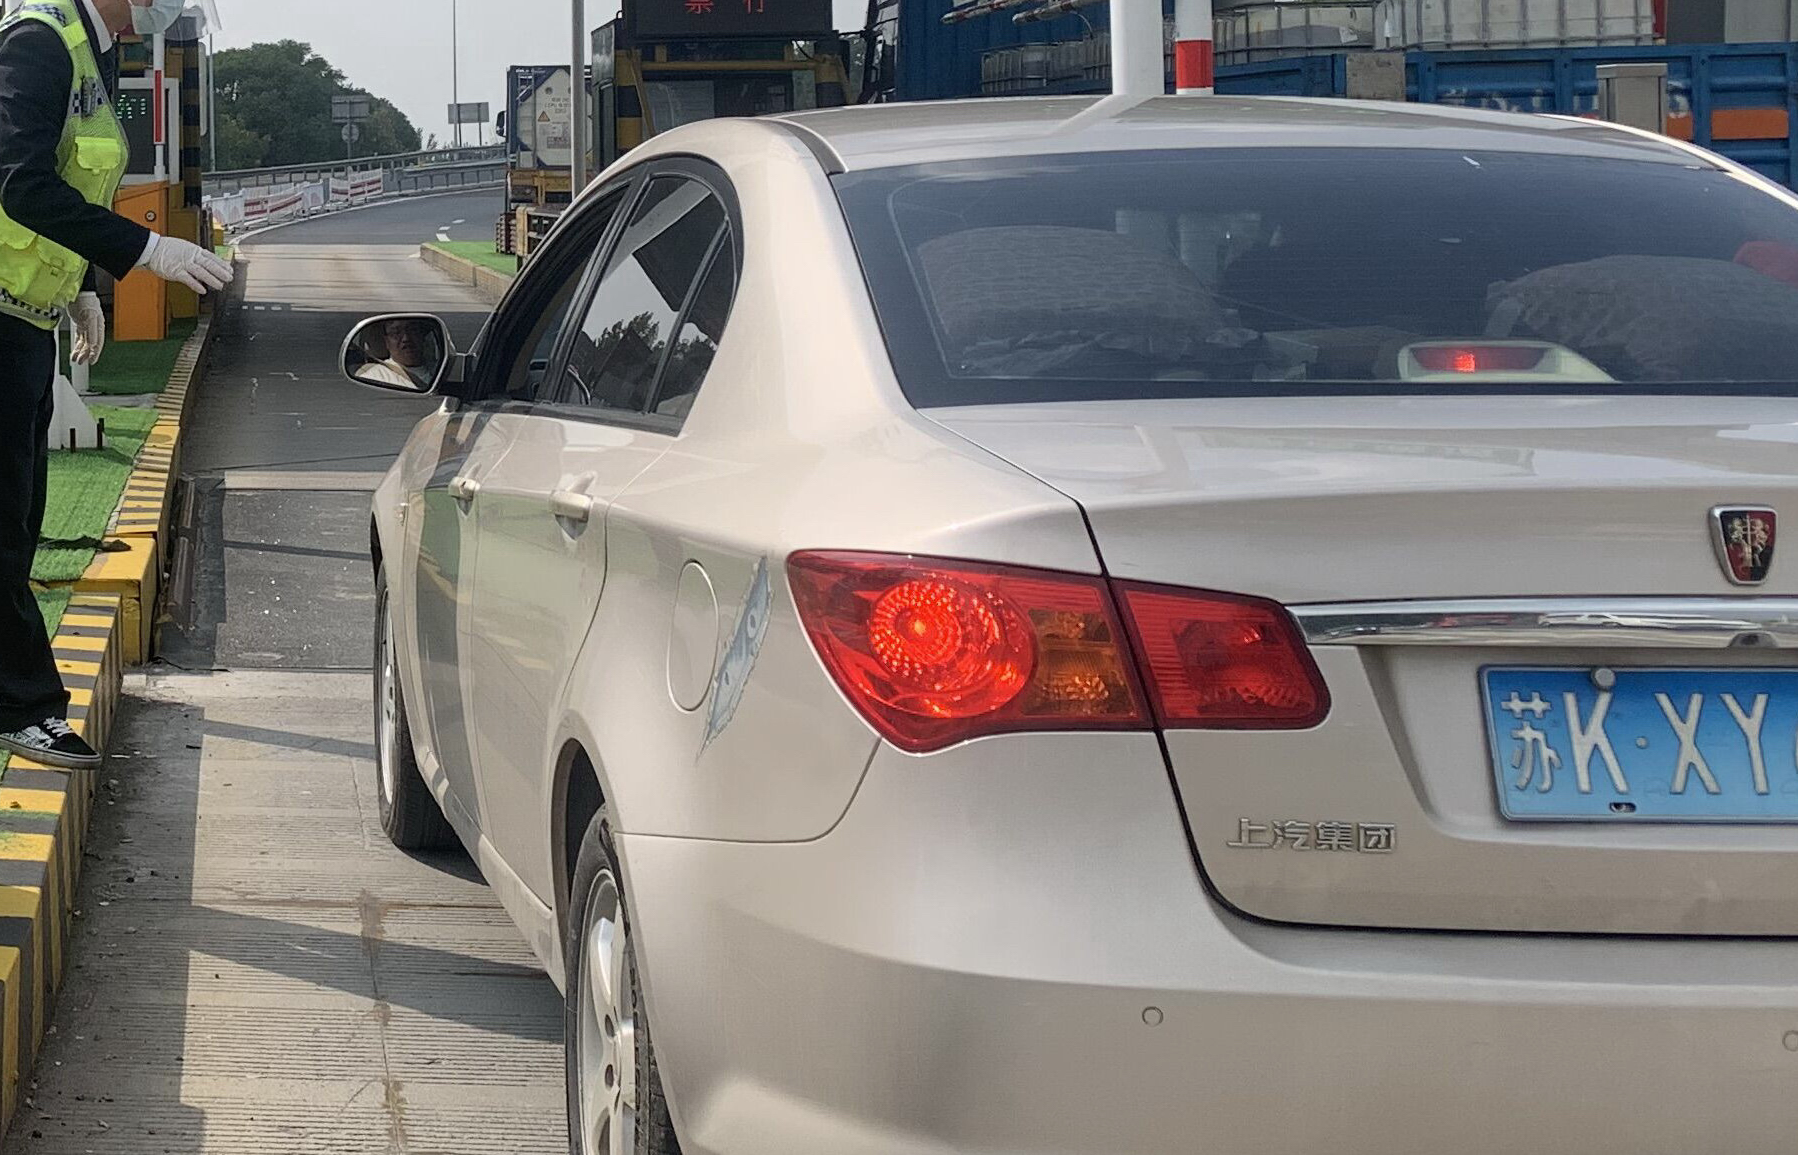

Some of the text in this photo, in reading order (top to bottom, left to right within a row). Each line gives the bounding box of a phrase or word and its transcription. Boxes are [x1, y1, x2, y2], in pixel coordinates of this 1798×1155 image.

[1500, 690, 1798, 795] 苏K·XY
[1226, 817, 1396, 854] 上汽集团
